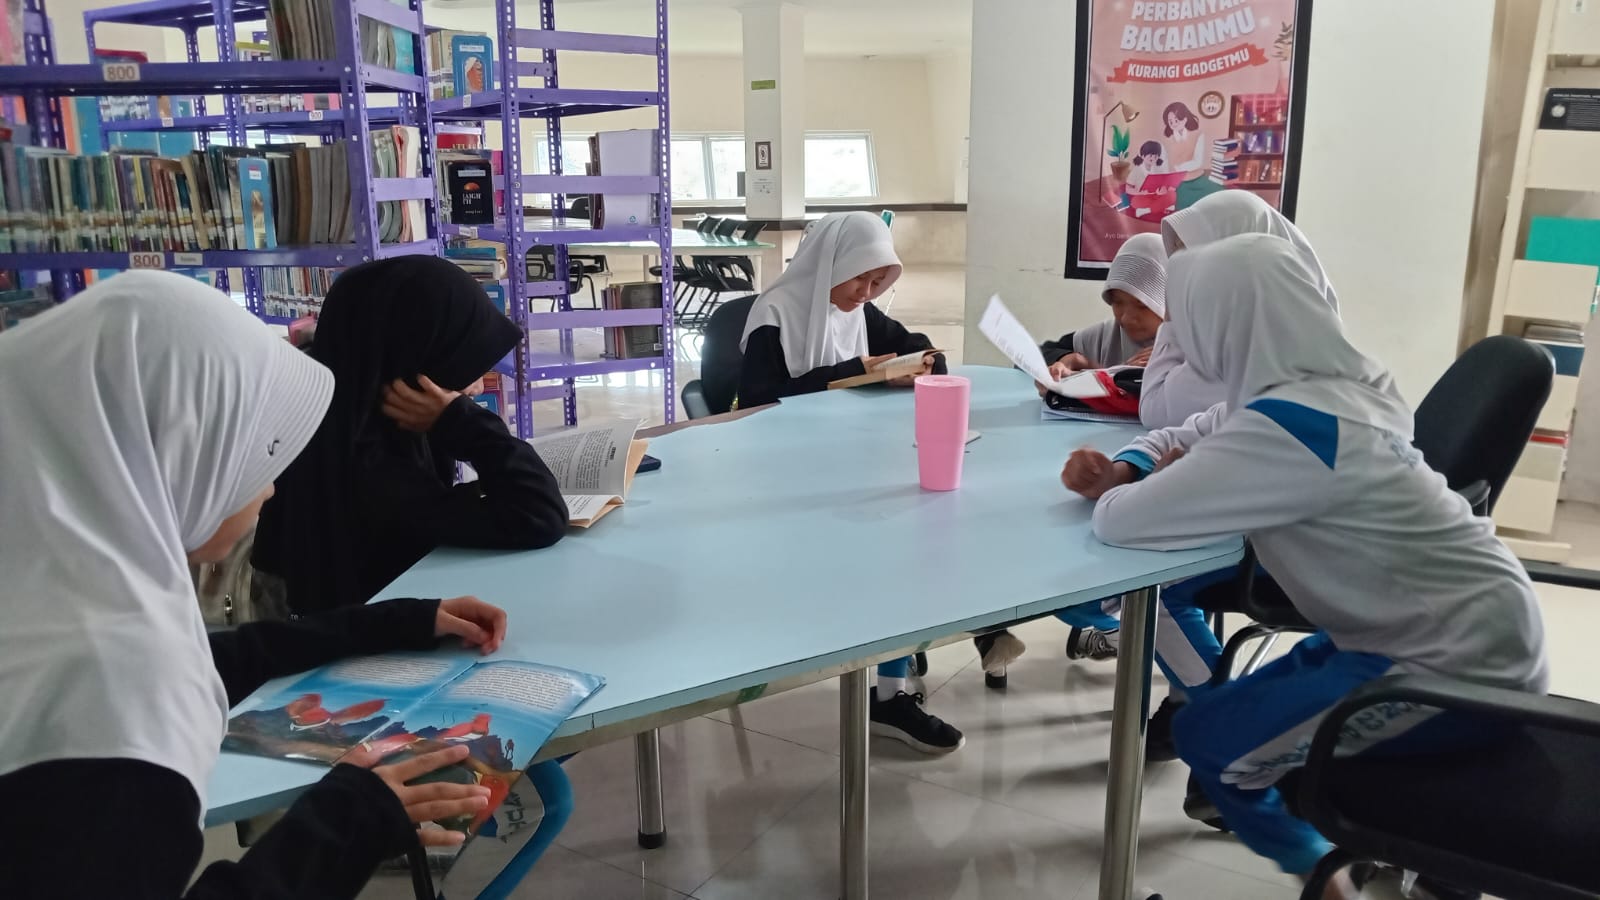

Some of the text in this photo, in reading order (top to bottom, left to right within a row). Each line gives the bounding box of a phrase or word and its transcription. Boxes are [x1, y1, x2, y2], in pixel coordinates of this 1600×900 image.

[1131, 0, 1245, 21] PERBANYA
[1120, 6, 1256, 53] BACAANMU
[106, 65, 136, 80] 800
[1127, 48, 1250, 79] KURANGI GADGETMU
[133, 254, 161, 268] 800
